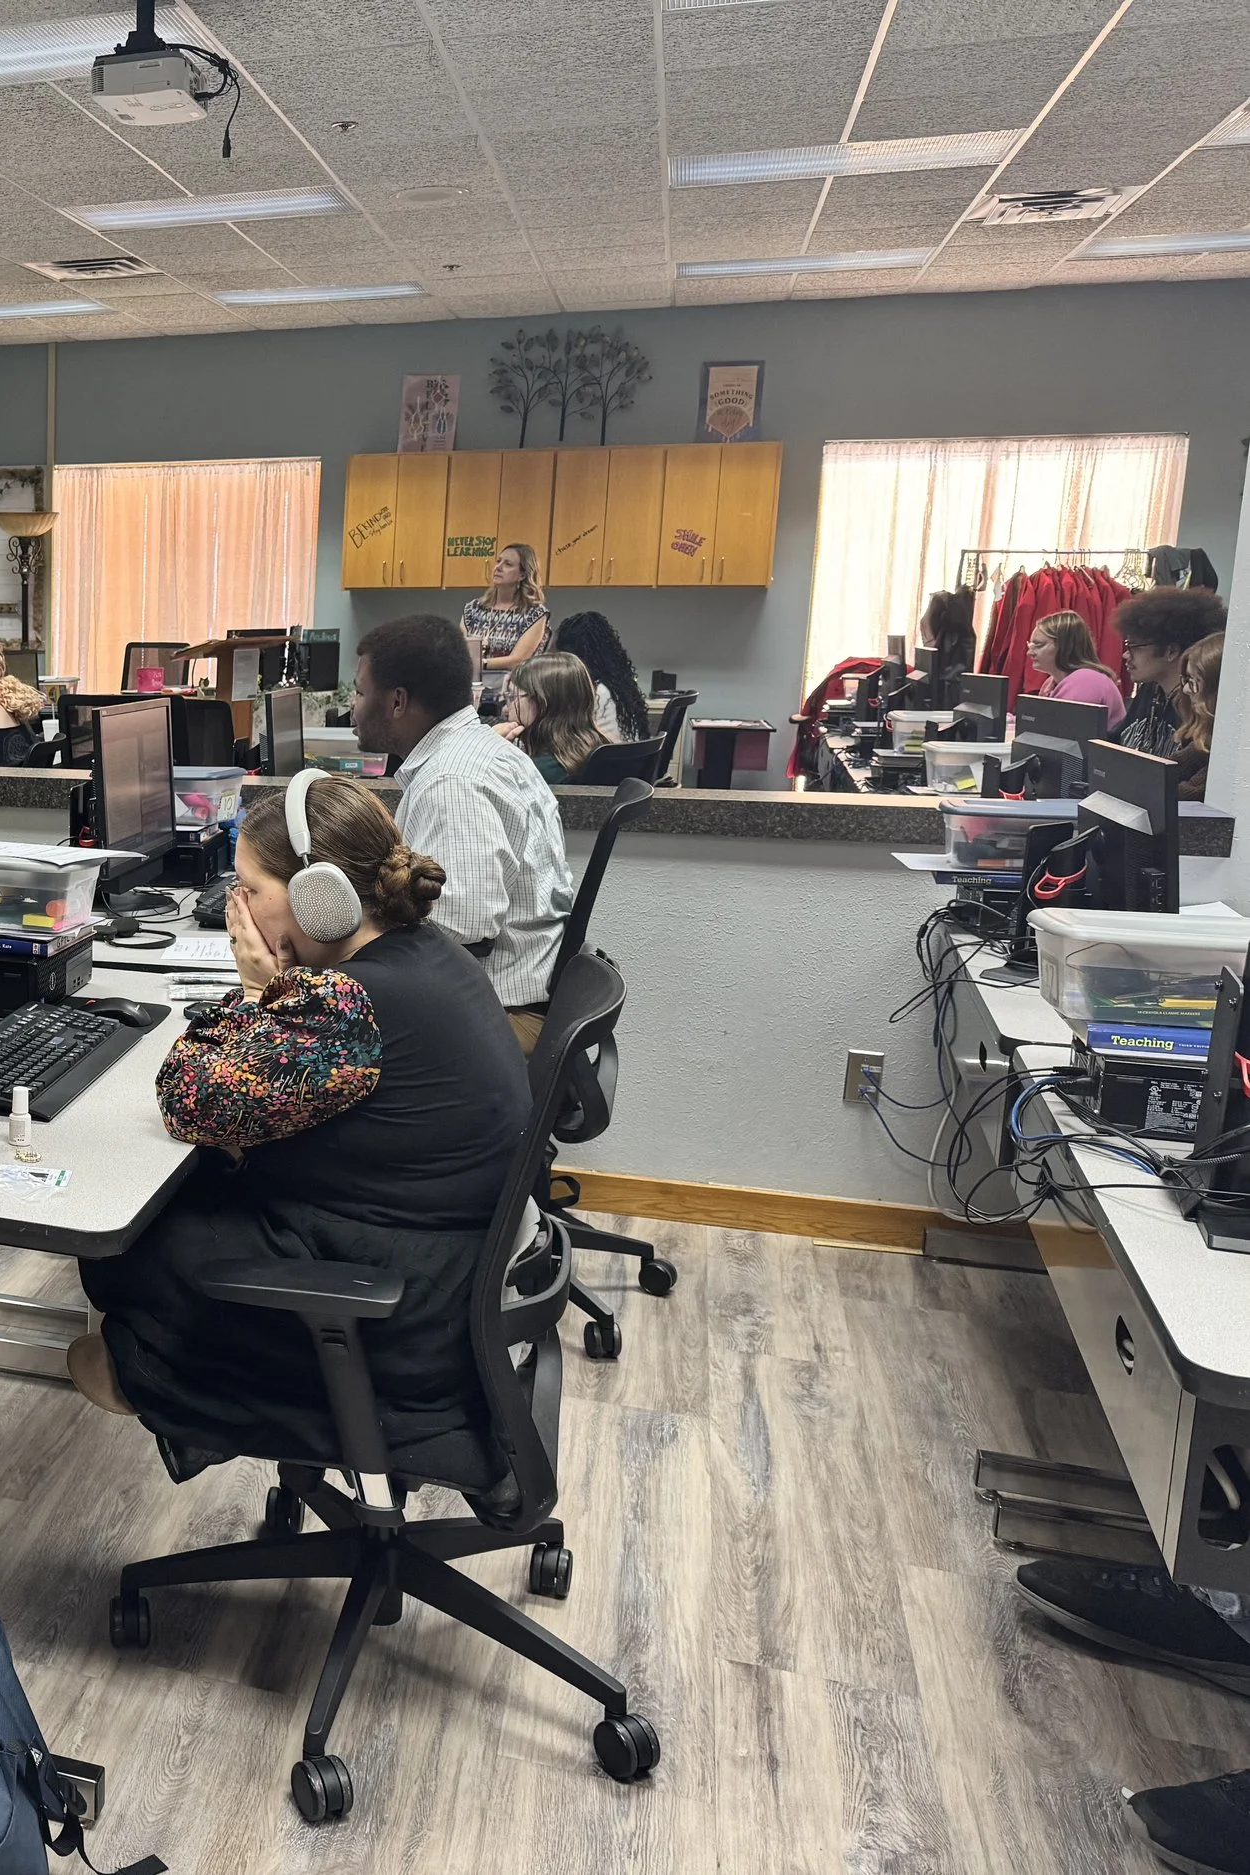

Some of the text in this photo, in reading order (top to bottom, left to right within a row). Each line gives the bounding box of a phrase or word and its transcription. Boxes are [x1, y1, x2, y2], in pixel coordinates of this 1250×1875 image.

[710, 389, 754, 400] SOMETHING
[718, 397, 745, 405] GOOD
[448, 536, 497, 546] NEVER STOP
[447, 547, 495, 556] LEARNING
[952, 876, 992, 885] Teaching
[1111, 1035, 1175, 1051] Teaching
